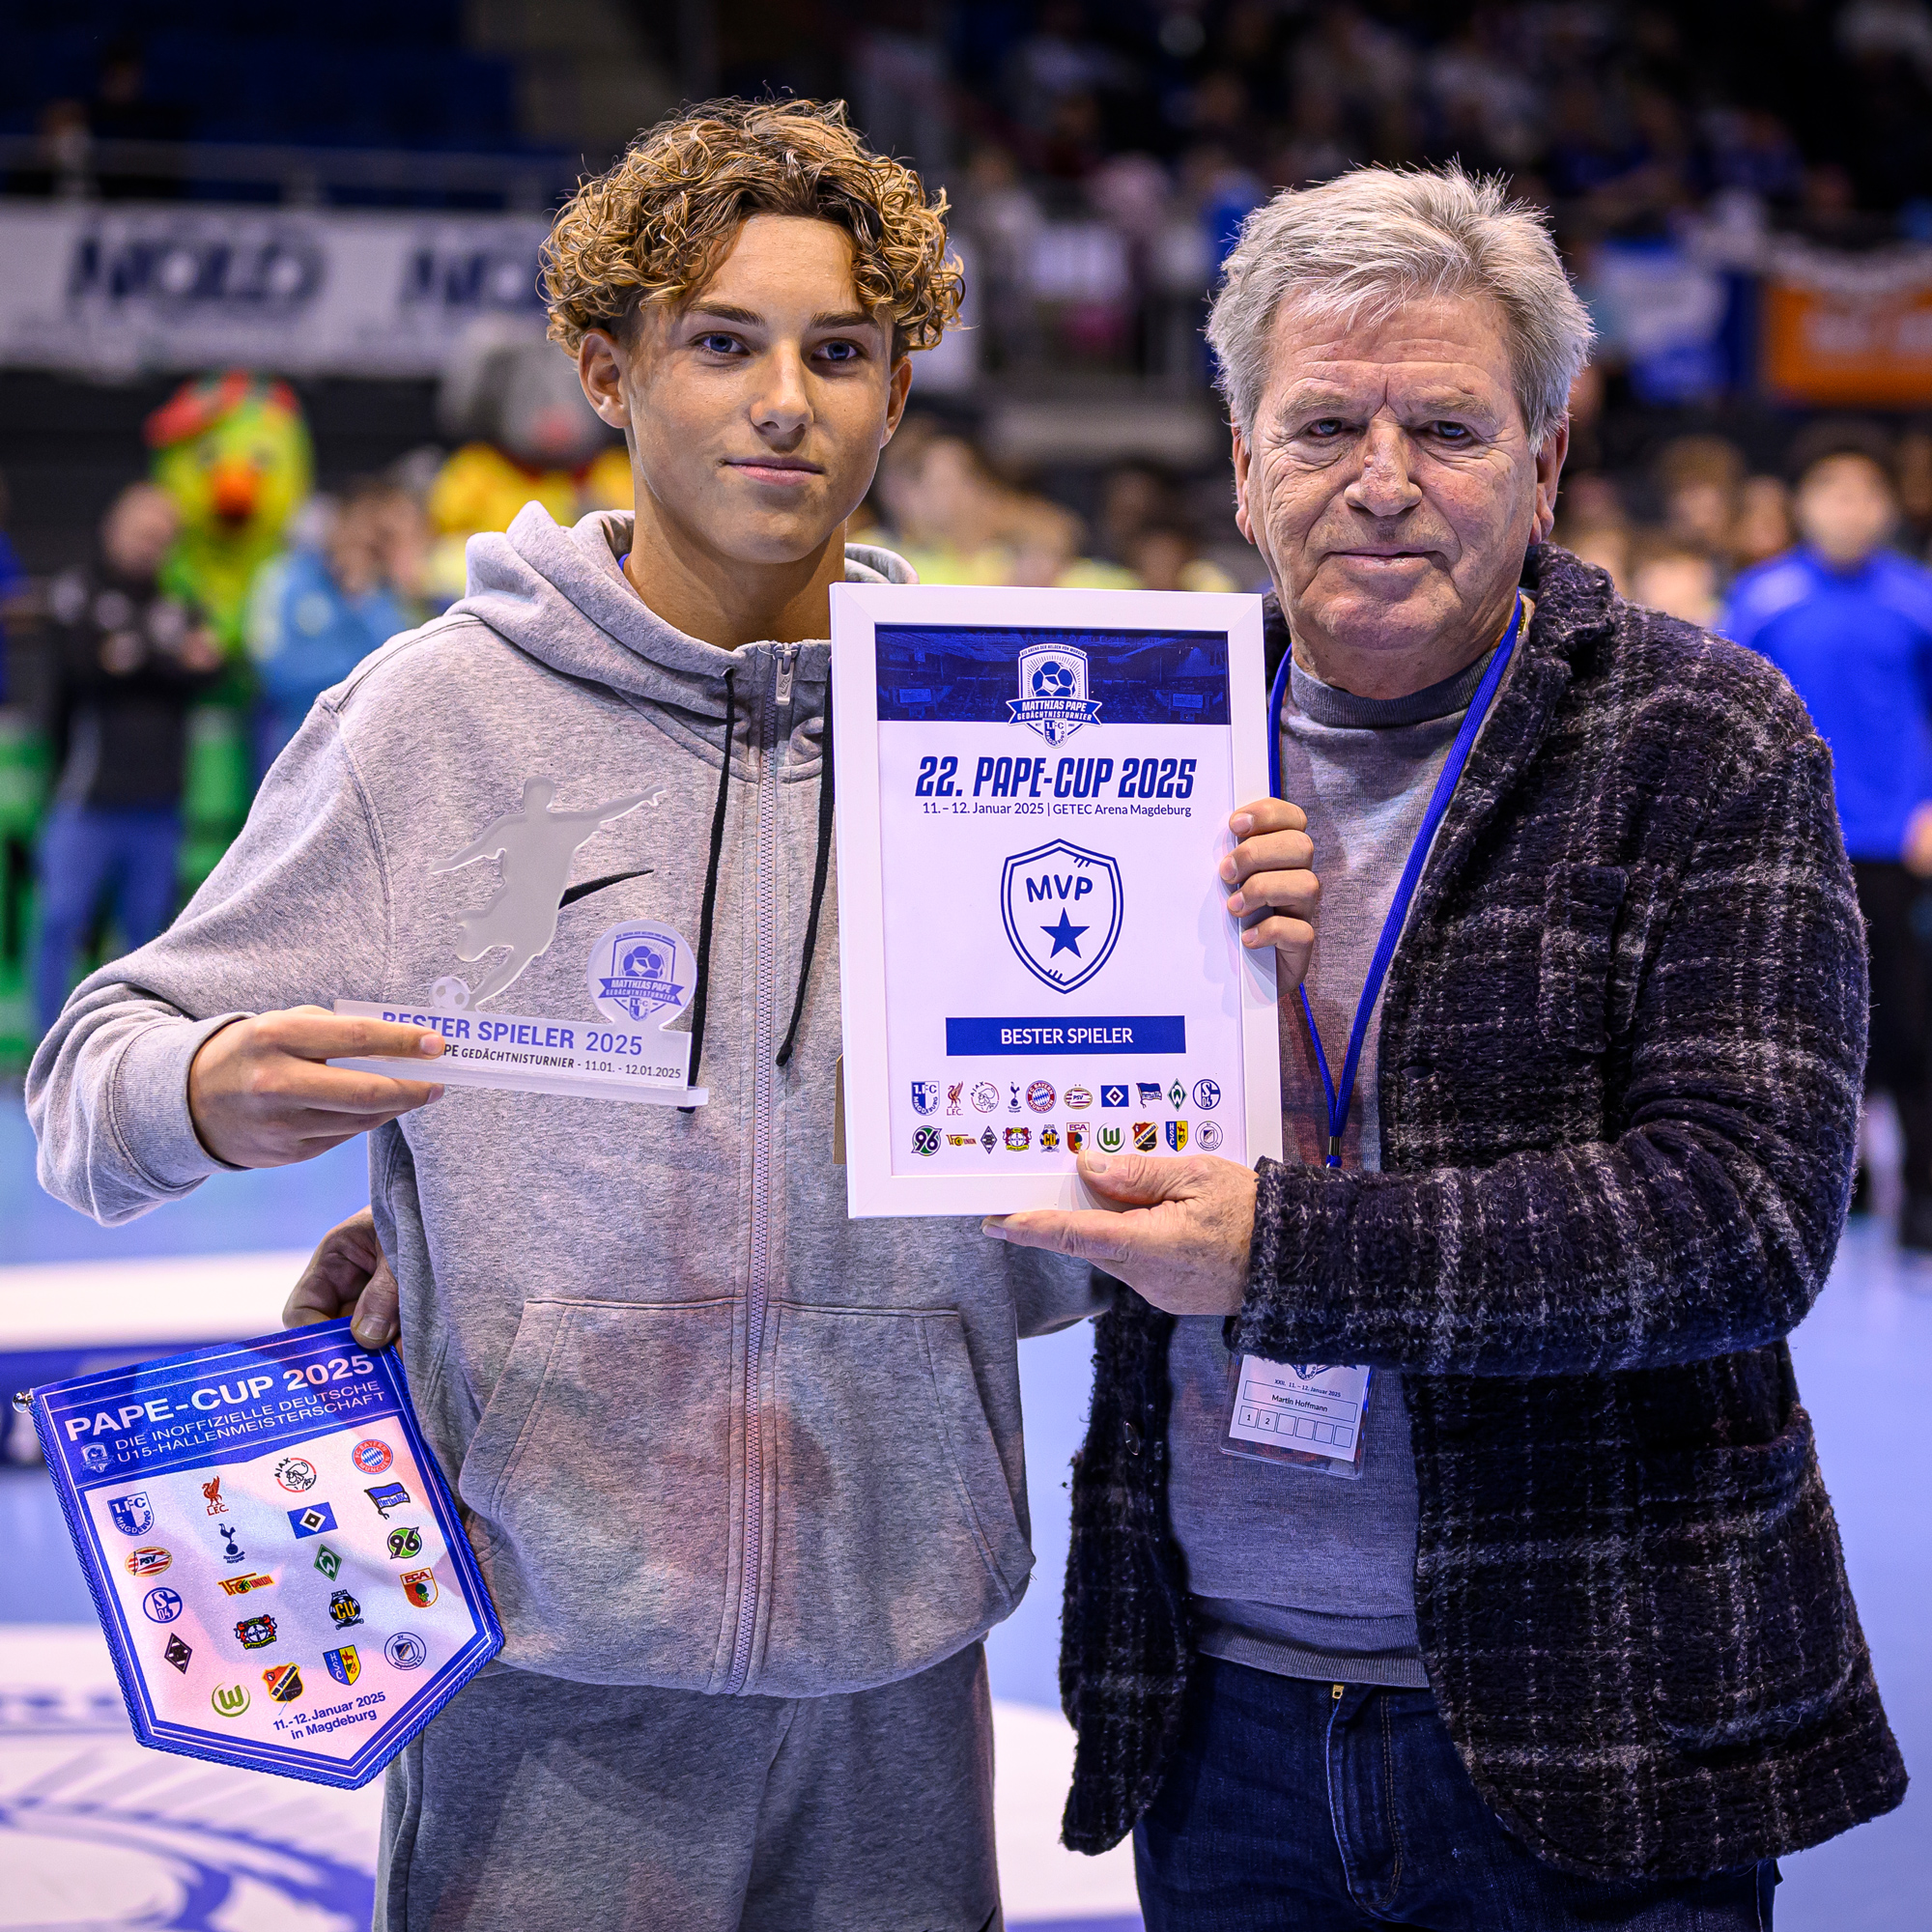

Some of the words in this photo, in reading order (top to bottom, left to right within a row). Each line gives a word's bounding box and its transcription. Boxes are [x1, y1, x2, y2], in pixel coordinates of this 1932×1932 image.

[1022, 700, 1065, 712] MATTHIAS
[1065, 700, 1088, 712] PAPE
[915, 756, 963, 797] 22.
[973, 756, 1114, 798] PAPE-CUP
[1118, 758, 1197, 799] 2025
[973, 802, 1011, 814] Januar
[1014, 803, 1044, 814] 2025
[1053, 804, 1092, 815] GETEC
[1094, 804, 1128, 815] Arena
[1130, 804, 1192, 817] Magdeburg
[1026, 874, 1094, 903] MVP
[611, 980, 651, 990] MATTHIAS
[651, 982, 672, 994] PAPE
[477, 1021, 575, 1049] SPIELER
[585, 1031, 642, 1056] 2025
[1001, 1028, 1064, 1044] BESTER
[1067, 1028, 1134, 1043] SPIELER
[443, 1044, 459, 1057] PE
[461, 1047, 575, 1068] GEDÄCHTNISTURNIER
[585, 1060, 615, 1073] 11.01.
[625, 1064, 681, 1079] 12.01.2025
[970, 1081, 984, 1096] AJAX
[915, 1130, 939, 1151] 96
[65, 1376, 274, 1441] PAPE-CUP
[282, 1354, 375, 1392] 2025
[1310, 1386, 1328, 1395] Januar
[1271, 1394, 1293, 1406] Martin
[1294, 1398, 1328, 1412] Hoffmann
[115, 1434, 146, 1450] DIE
[152, 1405, 274, 1442] INOFFIZIELLE
[279, 1380, 380, 1412] DEUTSCHE
[117, 1391, 385, 1463] U15-HALLENMEISTERSCHAFT
[274, 1457, 291, 1478] AJAX
[389, 1529, 419, 1557] 96
[139, 1554, 156, 1566] PSV
[334, 1601, 355, 1620] CU
[355, 1690, 386, 1709] 2025
[291, 1729, 304, 1740] in
[305, 1708, 378, 1737] Magdeburg
